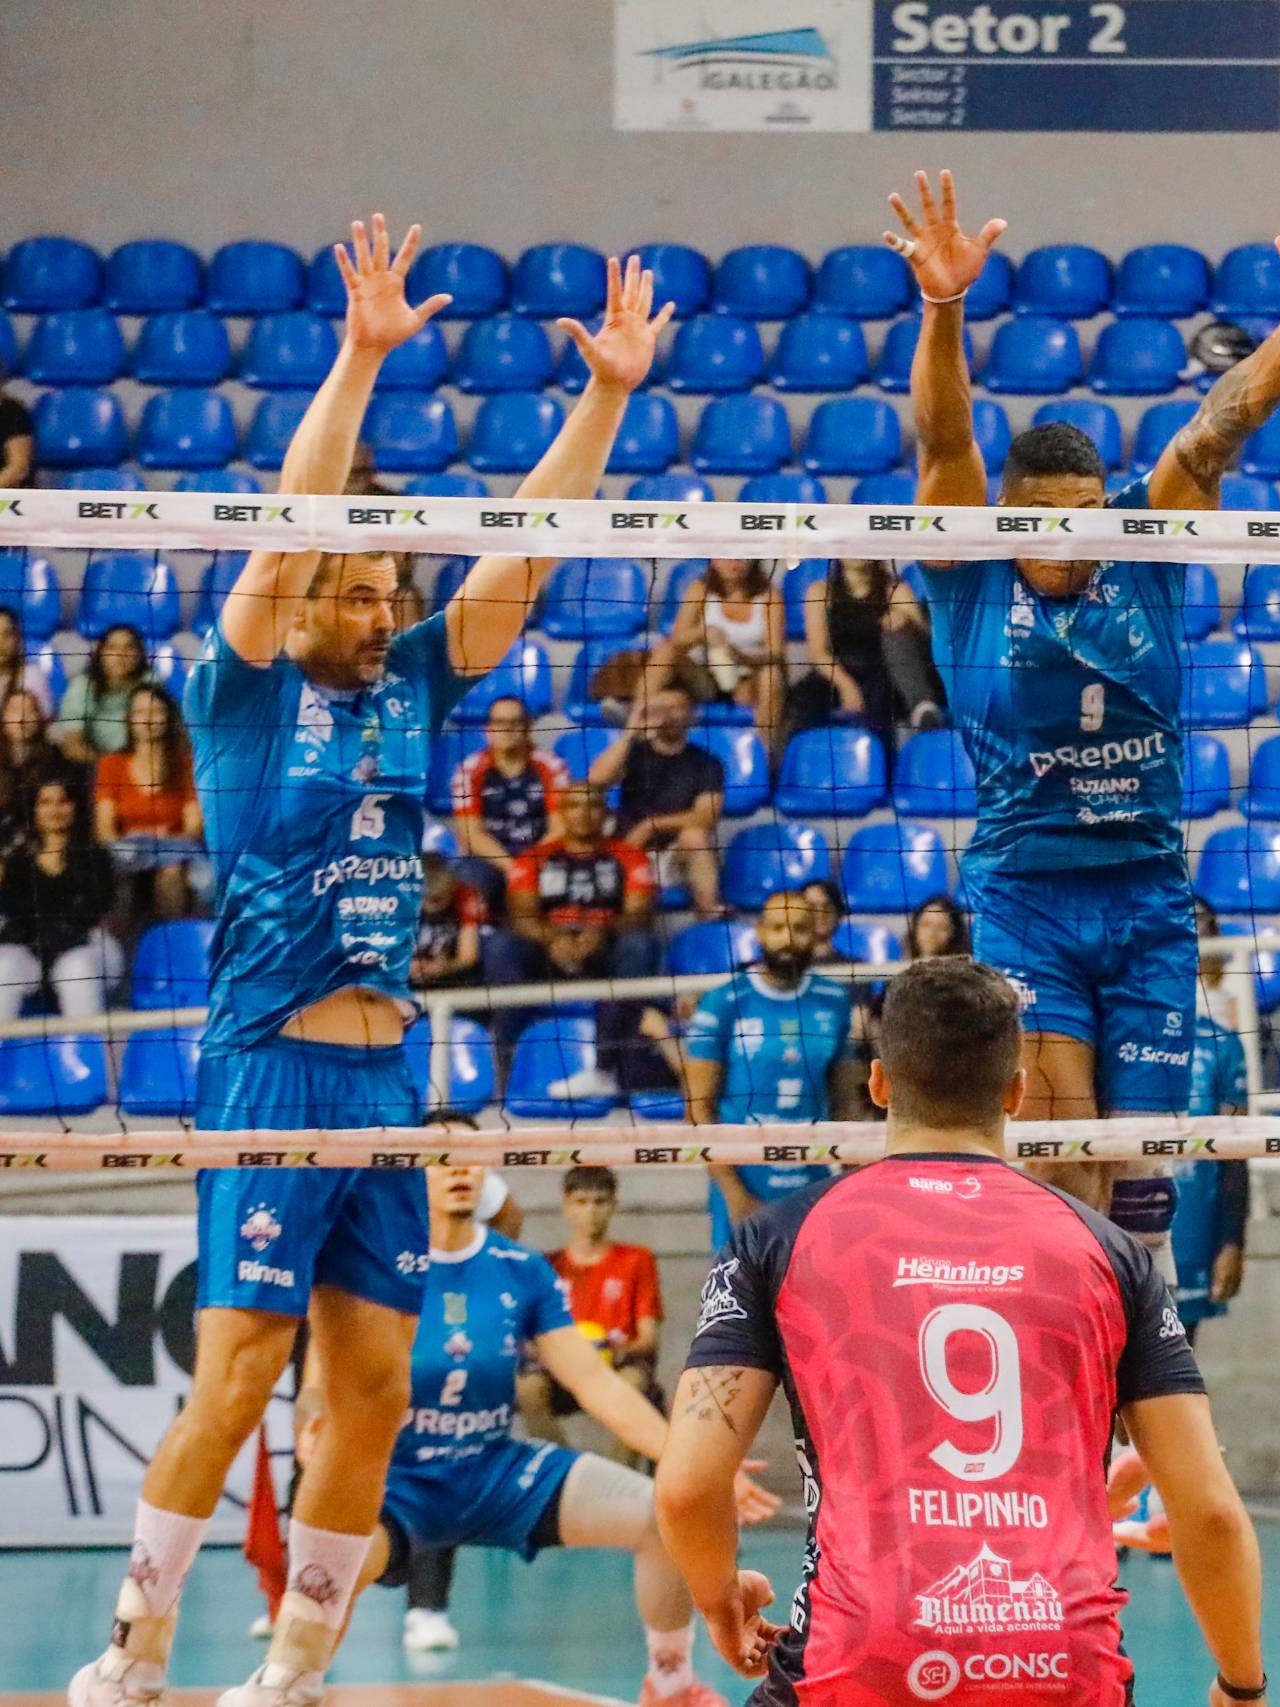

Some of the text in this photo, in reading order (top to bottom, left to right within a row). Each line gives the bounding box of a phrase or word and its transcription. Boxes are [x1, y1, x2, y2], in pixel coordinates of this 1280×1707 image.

[892, 2, 1128, 53] Setor 2
[79, 502, 159, 520] BET7K
[214, 504, 294, 523] BET7K
[348, 508, 428, 525] BET7K
[480, 511, 559, 528] BET7K
[612, 513, 690, 530] BET7K
[869, 515, 946, 532] BET7K
[997, 516, 1073, 533] BET7K
[1123, 519, 1199, 536] BET7K
[1081, 683, 1105, 732] 9
[1055, 732, 1166, 769] Report
[102, 1153, 183, 1168] BET7K
[238, 1151, 319, 1166] BET7K
[372, 1152, 451, 1168] BET7K
[504, 1149, 584, 1165] BET7K
[635, 1147, 713, 1163] BET7K
[763, 1145, 841, 1162] BET7K
[1017, 1141, 1094, 1157] BET7K
[1142, 1138, 1218, 1155] BET7K
[897, 1257, 1025, 1285] Hennings
[918, 1303, 1023, 1482] 9
[415, 1403, 509, 1440] Report
[909, 1488, 1048, 1528] FELIPINHO
[913, 1595, 1064, 1627] Blumenau
[935, 1621, 1061, 1635] Aqui a vida acontece
[964, 1653, 1068, 1680] CONSC
